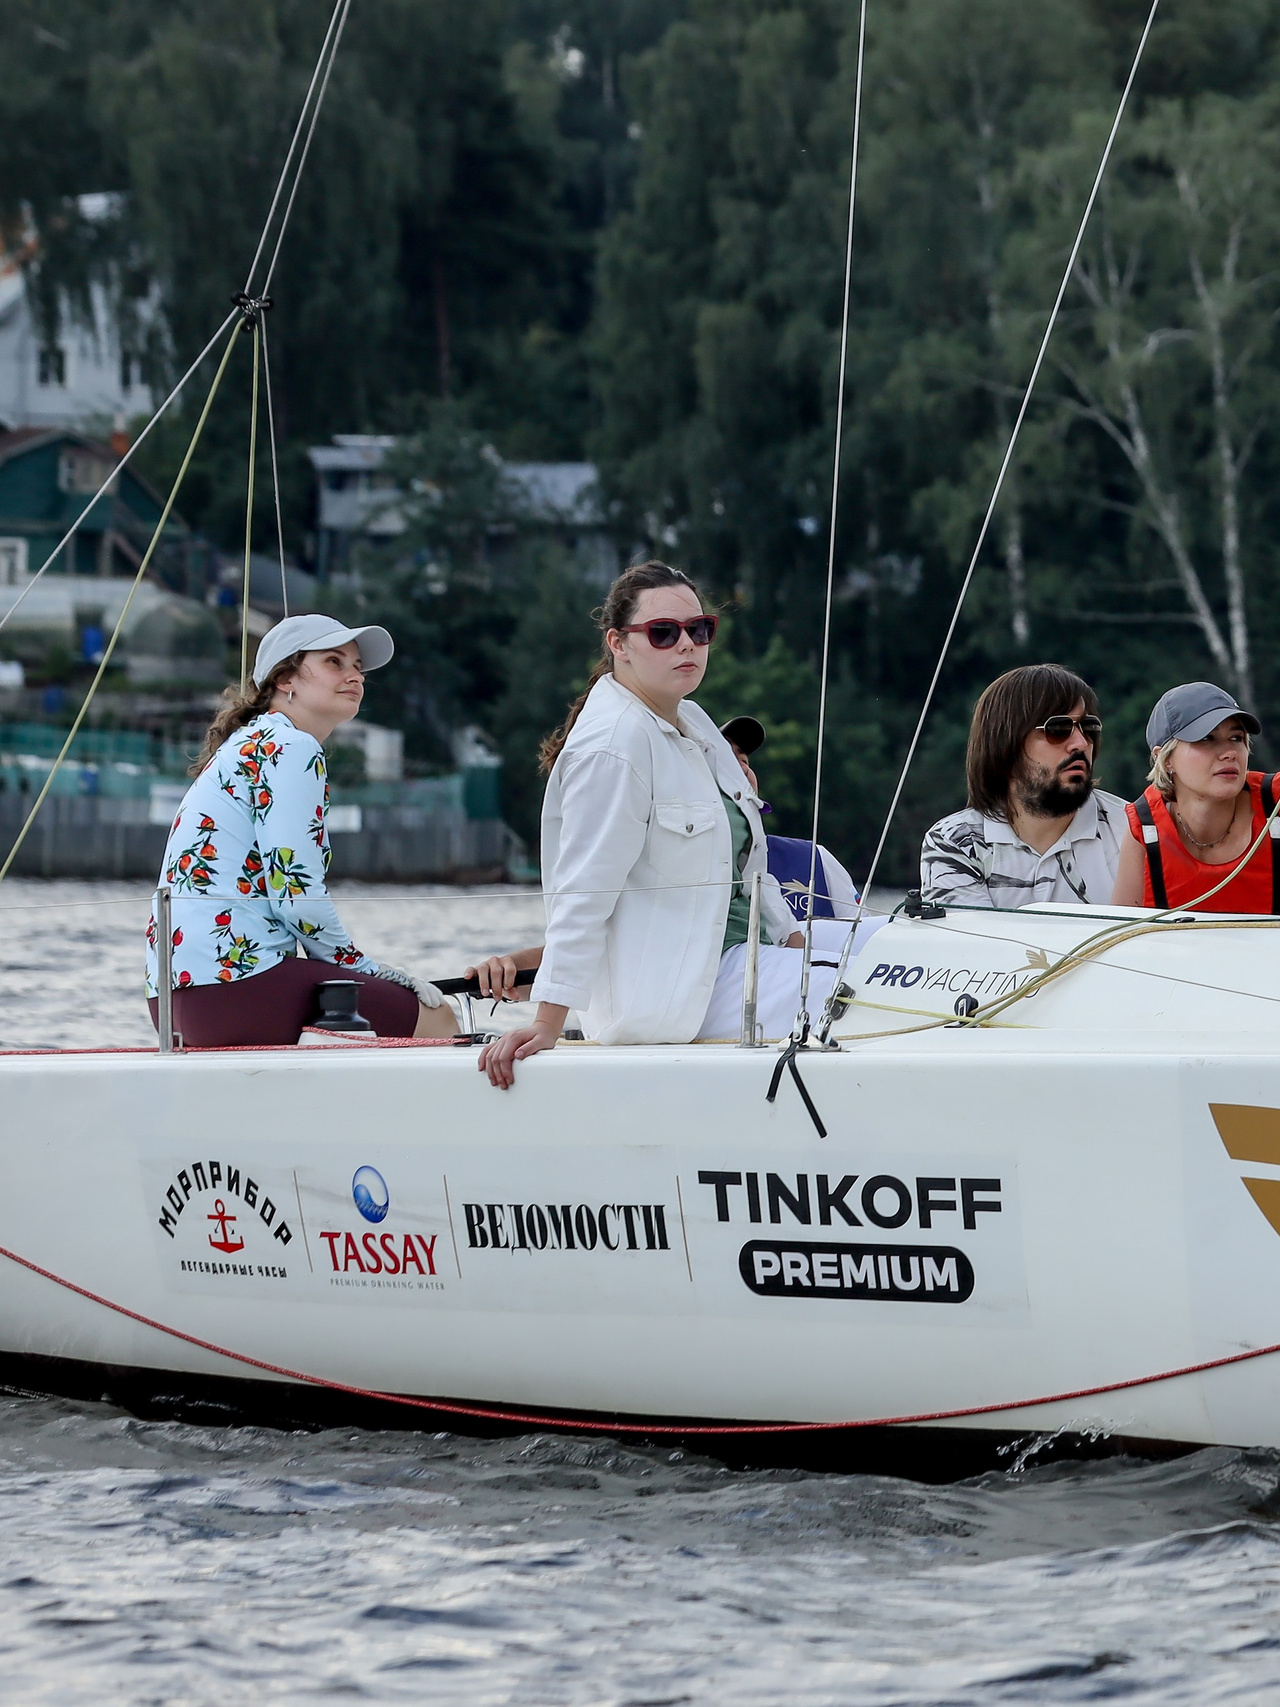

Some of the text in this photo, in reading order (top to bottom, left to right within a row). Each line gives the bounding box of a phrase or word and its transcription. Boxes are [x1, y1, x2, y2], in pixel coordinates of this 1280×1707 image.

[158, 1160, 293, 1247] МОРПРИБОР
[698, 1170, 1002, 1231] TINKOFF
[462, 1203, 671, 1256] ВЕДОМОСТИ
[180, 1260, 288, 1278] ЛЕГЕНДАРНЫЕ ЧАСЫ
[319, 1231, 438, 1276] TASSAY
[752, 1250, 960, 1292] PREMIUM
[330, 1278, 446, 1291] PREMIUM DRINKING WATER
